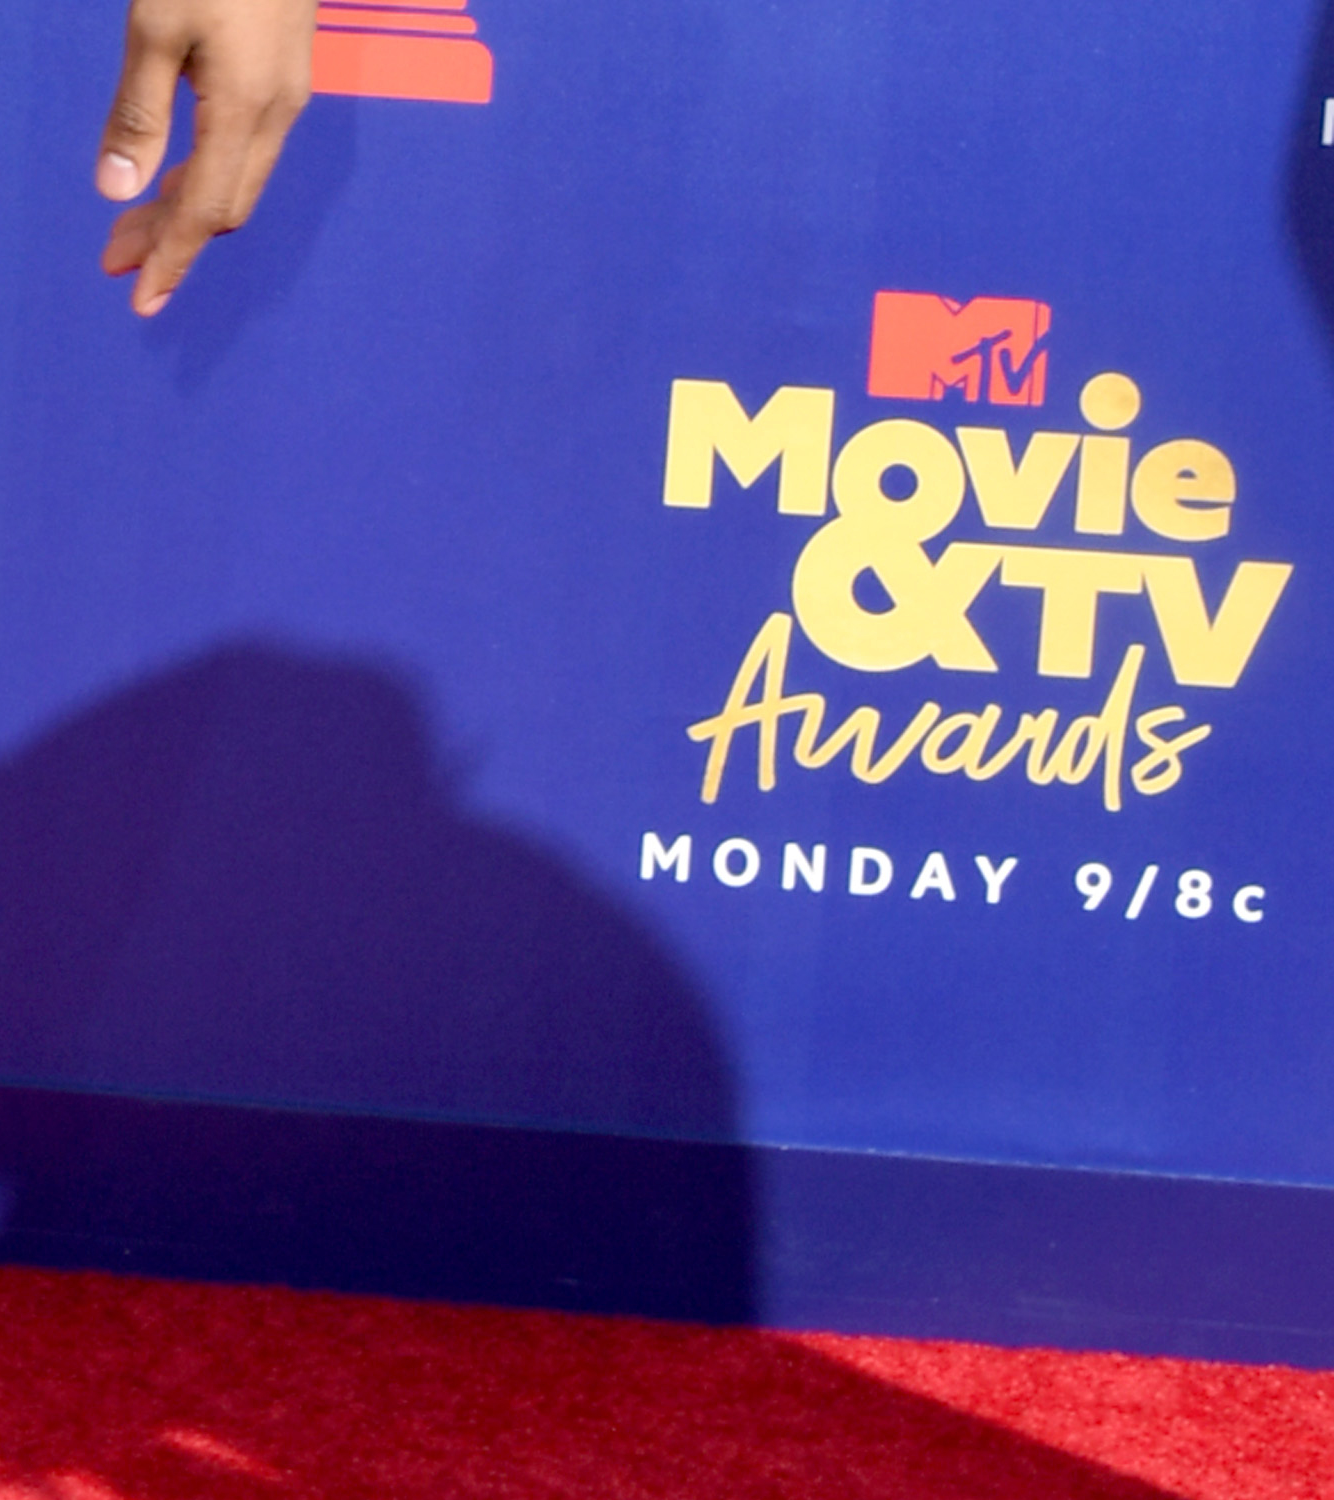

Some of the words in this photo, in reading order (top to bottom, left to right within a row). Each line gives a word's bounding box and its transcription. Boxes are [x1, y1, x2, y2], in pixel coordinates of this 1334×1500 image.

[867, 290, 1053, 407] MTV
[663, 372, 1236, 542] Movie
[687, 612, 1212, 812] Awards
[640, 832, 1019, 904] MONDAY
[1074, 861, 1265, 924] 9/8c
